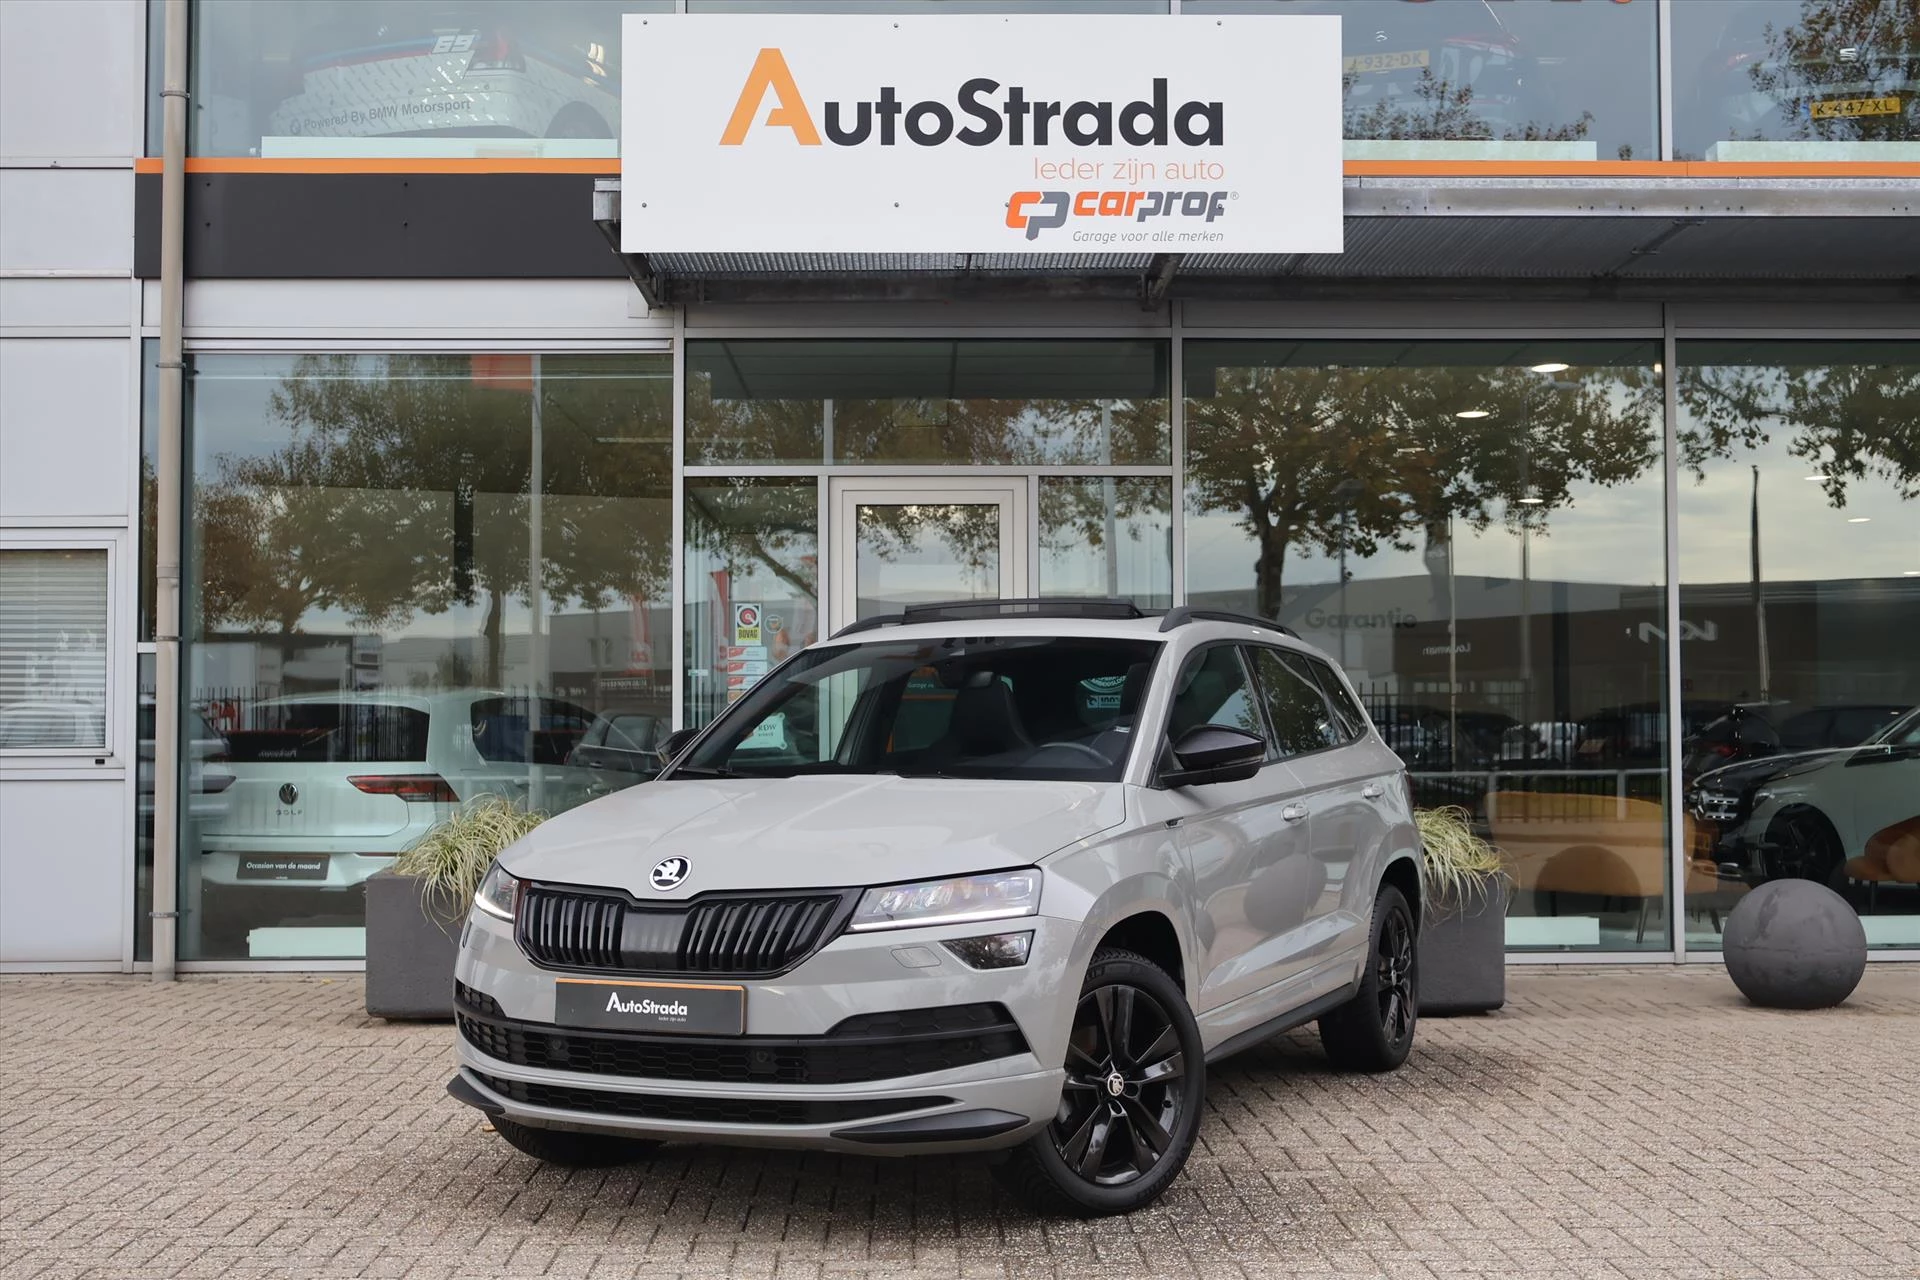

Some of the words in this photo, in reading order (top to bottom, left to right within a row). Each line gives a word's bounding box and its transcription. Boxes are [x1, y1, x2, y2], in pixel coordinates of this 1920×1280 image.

[432, 35, 475, 53] 69
[719, 47, 1225, 146] AutoStrada
[304, 110, 348, 129] Powered
[351, 110, 366, 125] By
[368, 105, 399, 119] BMW
[401, 99, 472, 116] Motorsport
[1816, 101, 1893, 115] K-447-XL
[1034, 157, 1105, 180] Ieder
[1113, 158, 1156, 186] zijn
[1165, 159, 1225, 181] auto
[1073, 191, 1228, 223] carprof
[1073, 230, 1117, 244] Garage
[1121, 231, 1149, 242] voor
[1152, 230, 1175, 242] alle
[1178, 230, 1225, 242] merken
[1304, 607, 1418, 629] Garantie
[738, 630, 758, 639] BOVAG
[246, 861, 275, 871] Occasion
[275, 862, 288, 870] van
[288, 861, 297, 870] de
[297, 861, 321, 870] maand
[606, 992, 688, 1015] AutoStrada
